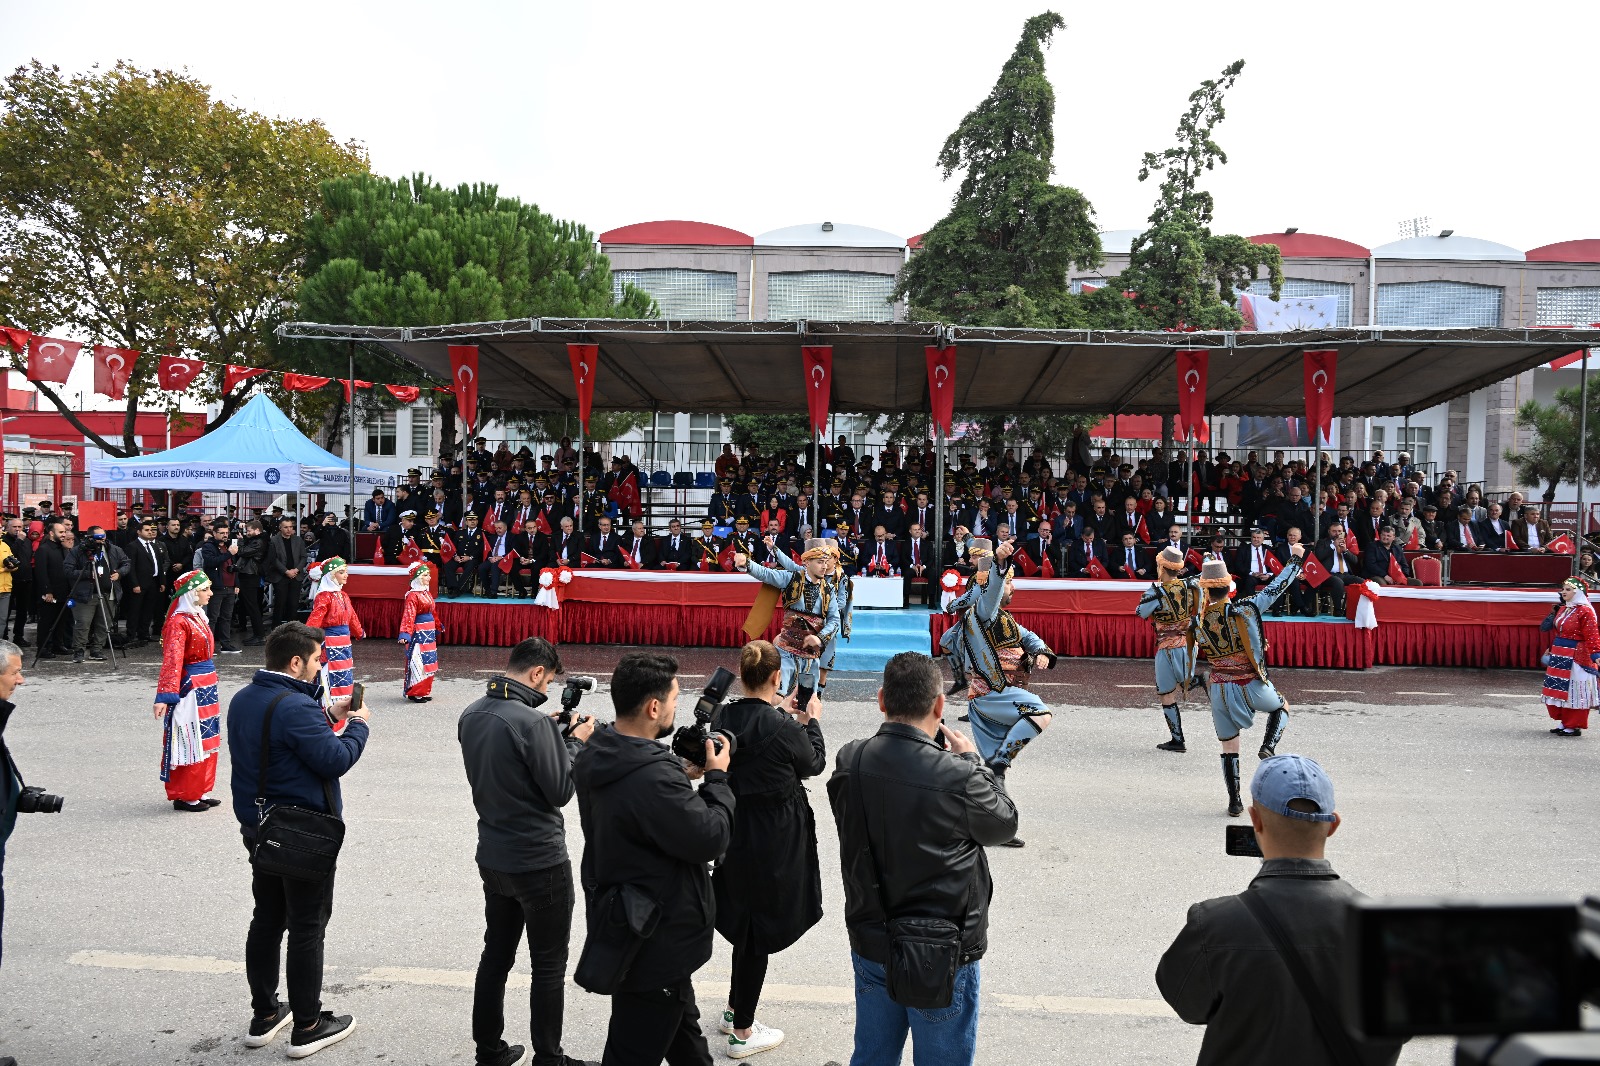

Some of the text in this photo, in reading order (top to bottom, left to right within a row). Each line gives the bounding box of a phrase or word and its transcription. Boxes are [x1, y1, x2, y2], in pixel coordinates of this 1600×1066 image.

[132, 468, 257, 479] BALIKESİR BÜYÜKŞEHİR BELEDİYESİ
